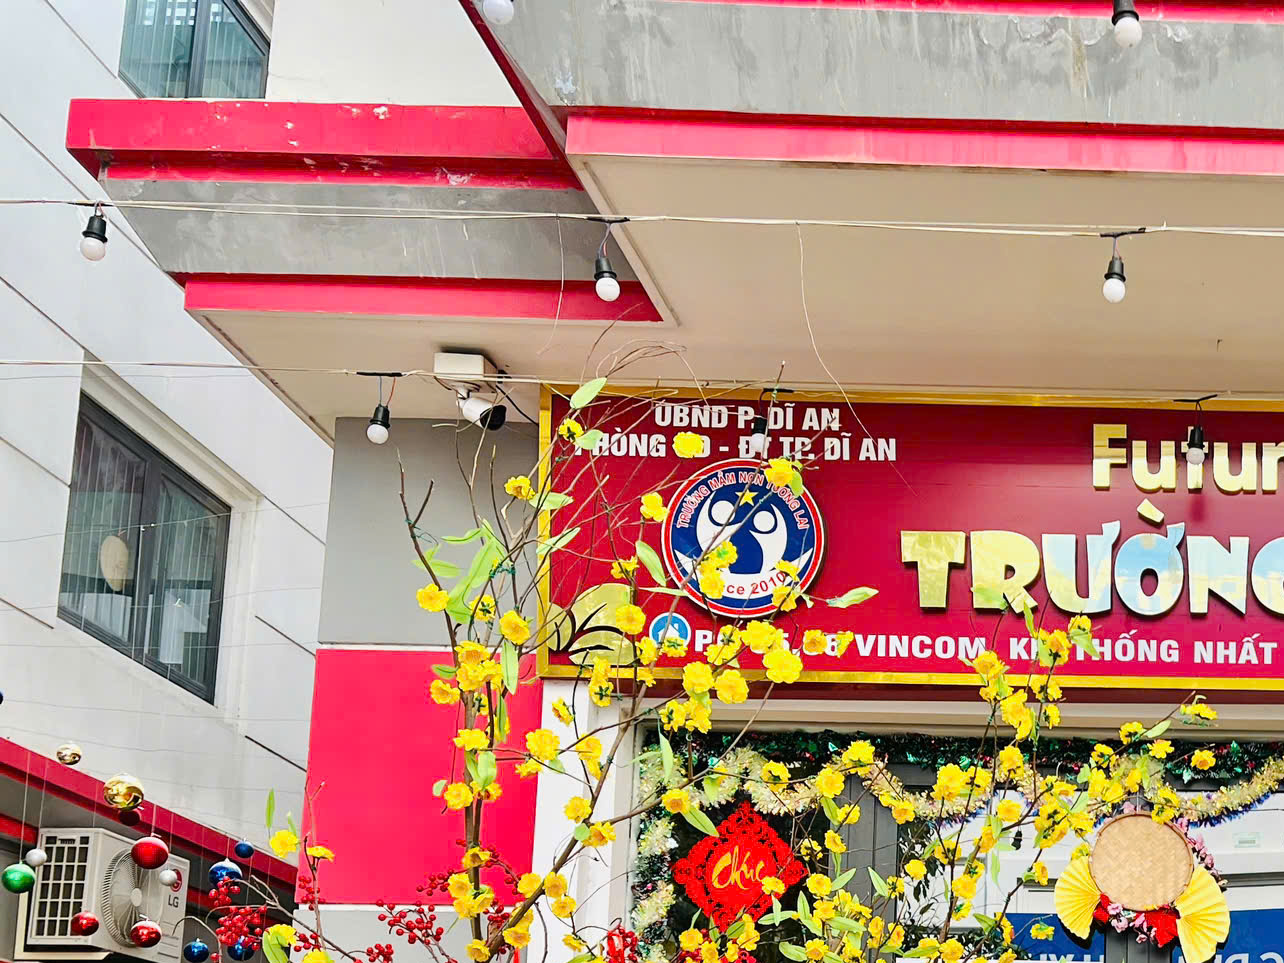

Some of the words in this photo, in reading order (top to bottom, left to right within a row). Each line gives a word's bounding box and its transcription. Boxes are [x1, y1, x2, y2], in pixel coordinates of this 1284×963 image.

[654, 403, 728, 429] UBND
[767, 403, 795, 430] DĨ
[802, 407, 841, 432] AN
[824, 432, 851, 461] DĨ
[858, 437, 897, 461] AN
[751, 572, 787, 596] 2010
[1194, 633, 1277, 665] NHẤT
[167, 896, 179, 908] LG
